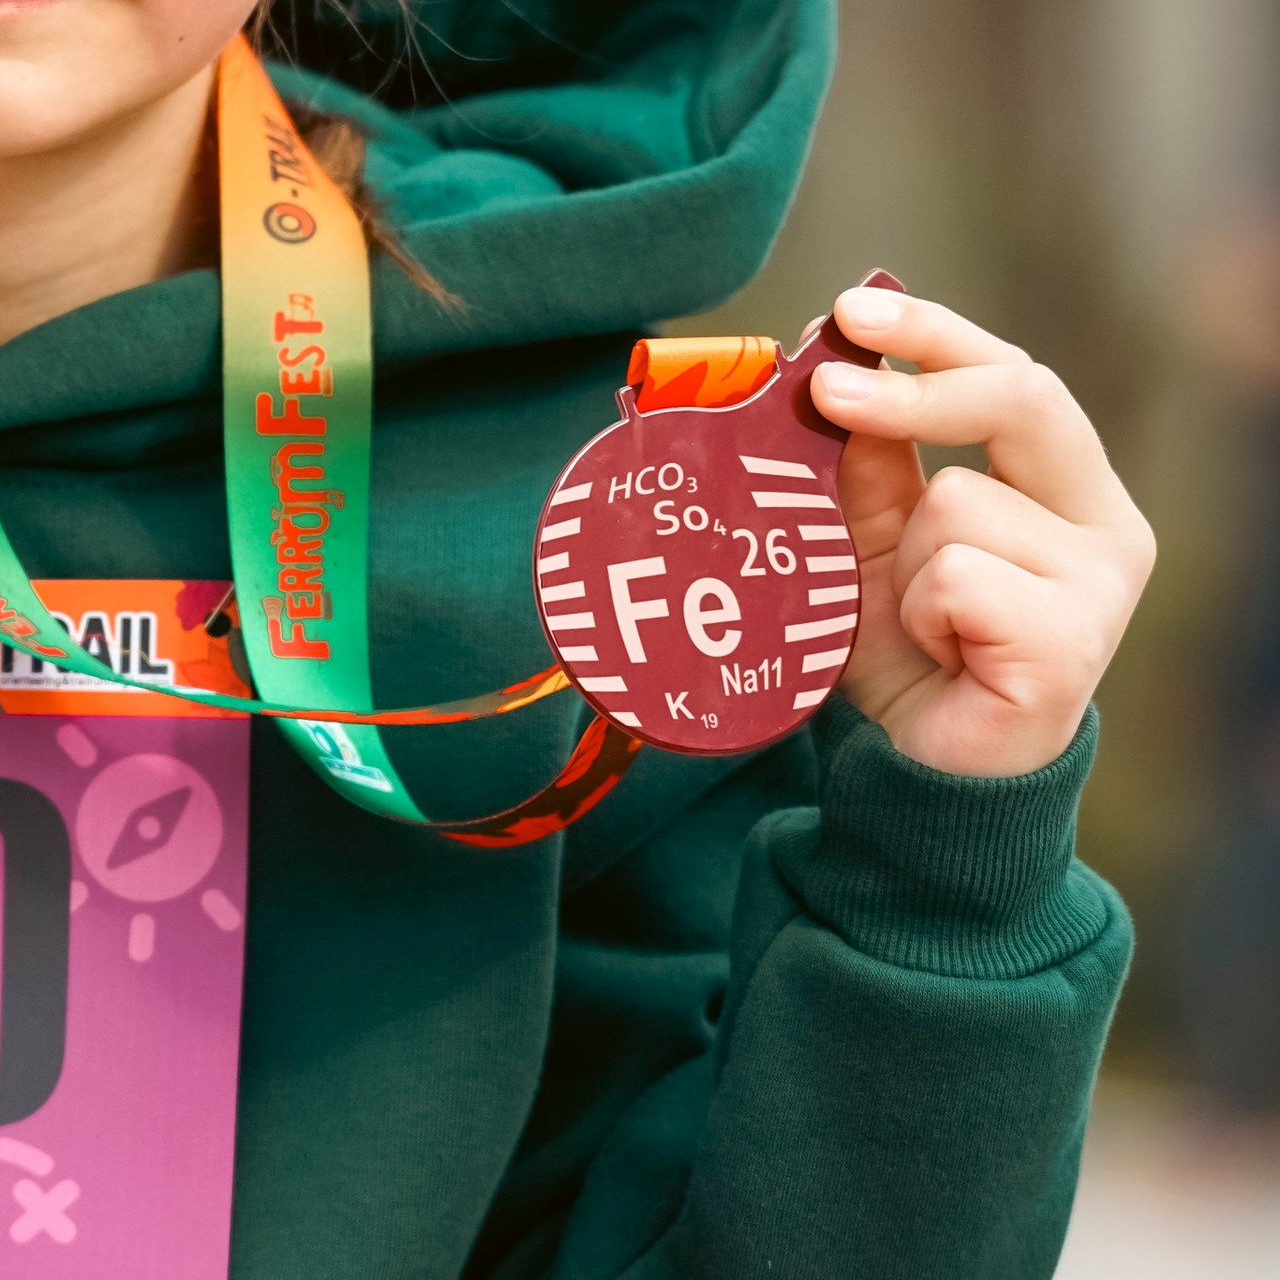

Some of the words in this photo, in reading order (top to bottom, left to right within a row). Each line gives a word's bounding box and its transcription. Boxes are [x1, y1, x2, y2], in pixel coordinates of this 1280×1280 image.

[732, 528, 797, 578] 26
[606, 555, 743, 664] Fe
[720, 657, 783, 697] Na11
